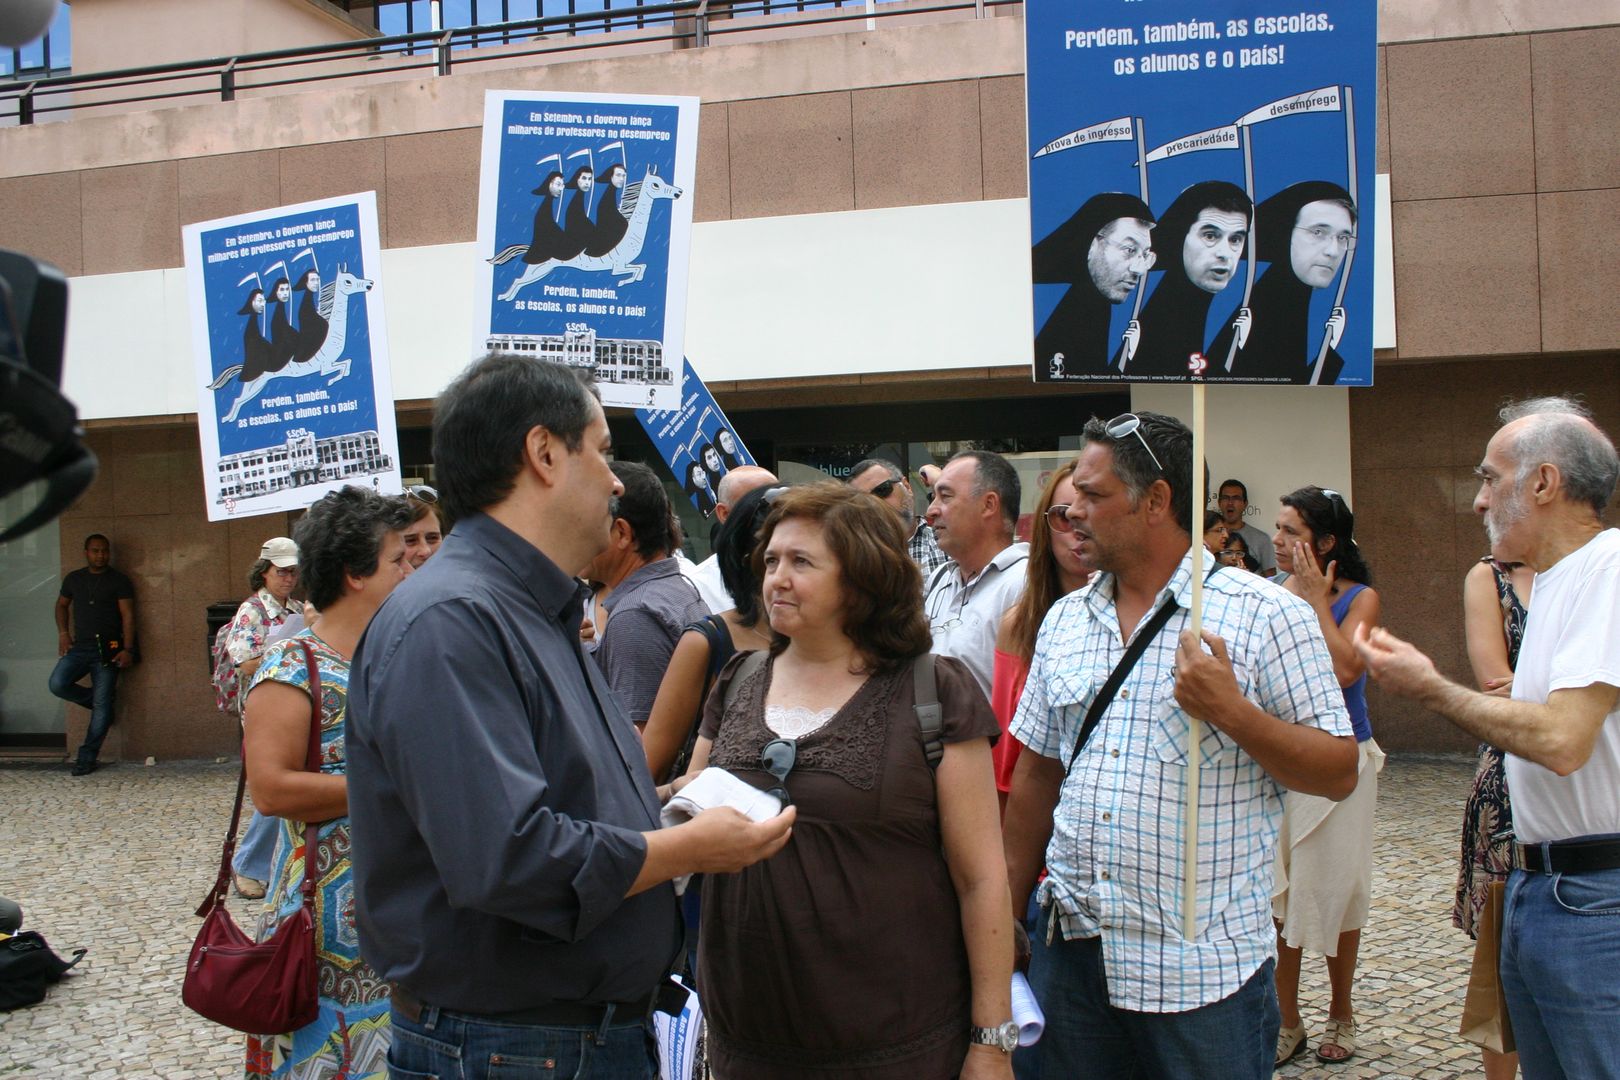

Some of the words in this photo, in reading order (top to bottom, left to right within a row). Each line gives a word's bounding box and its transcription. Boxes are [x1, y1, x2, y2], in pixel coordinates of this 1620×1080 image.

[1064, 27, 1139, 50] Perdem,
[1143, 18, 1221, 43] também,
[1226, 18, 1248, 37] as
[1253, 11, 1334, 35] escolas,
[1113, 56, 1136, 76] os
[1140, 49, 1200, 74] alunos
[1205, 49, 1217, 69] e
[1222, 49, 1234, 69] o
[1240, 44, 1285, 69] país!
[1269, 93, 1337, 117] desemprego
[529, 112, 542, 122] Em
[586, 116, 592, 124] o
[593, 114, 628, 126] Governo
[630, 115, 652, 127] lança
[507, 125, 543, 136] milhares
[544, 125, 555, 136] de
[556, 126, 606, 138] professores
[607, 129, 618, 139] no
[619, 128, 671, 141] desemprego
[1044, 137, 1072, 154] prova
[1073, 131, 1086, 144] de
[1087, 124, 1131, 142] ingresso
[1164, 130, 1236, 156] precariedade
[207, 249, 240, 264] milhares
[240, 247, 250, 257] de
[251, 239, 296, 256] professores
[297, 237, 307, 247] no
[308, 229, 355, 245] desemprego
[225, 236, 237, 248] Em
[282, 223, 314, 237] Governo
[515, 300, 525, 310] as
[566, 303, 577, 313] os
[578, 303, 607, 315] alunos
[609, 305, 615, 315] e
[617, 306, 623, 316] o
[238, 418, 248, 428] as
[283, 410, 294, 421] os
[295, 407, 322, 419] alunos
